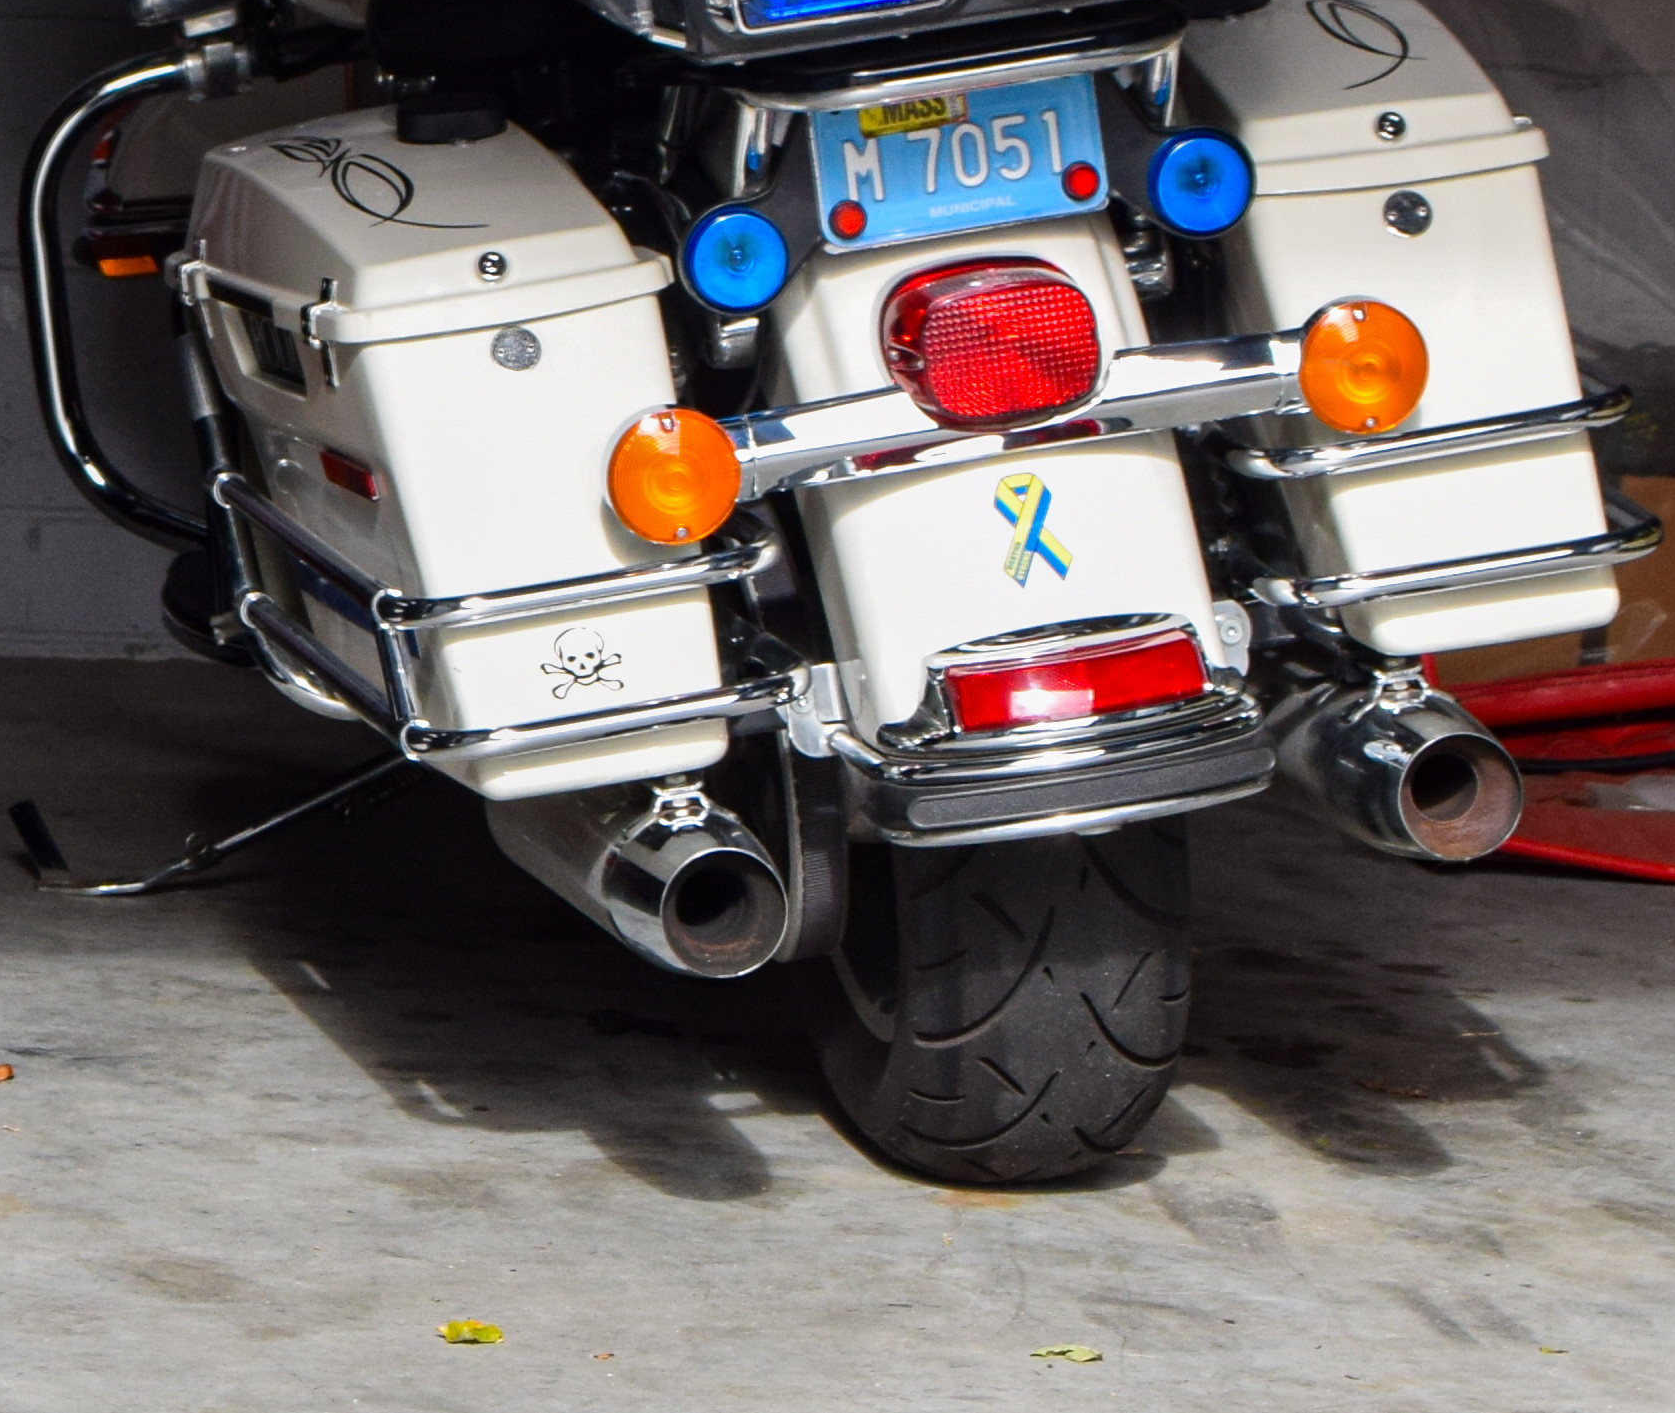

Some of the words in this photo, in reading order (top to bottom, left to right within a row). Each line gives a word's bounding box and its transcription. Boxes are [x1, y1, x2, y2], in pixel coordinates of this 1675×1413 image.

[882, 97, 946, 124] MASS
[844, 138, 884, 201] M
[907, 110, 1062, 194] 7051
[930, 196, 1015, 218] MUNICIPAL
